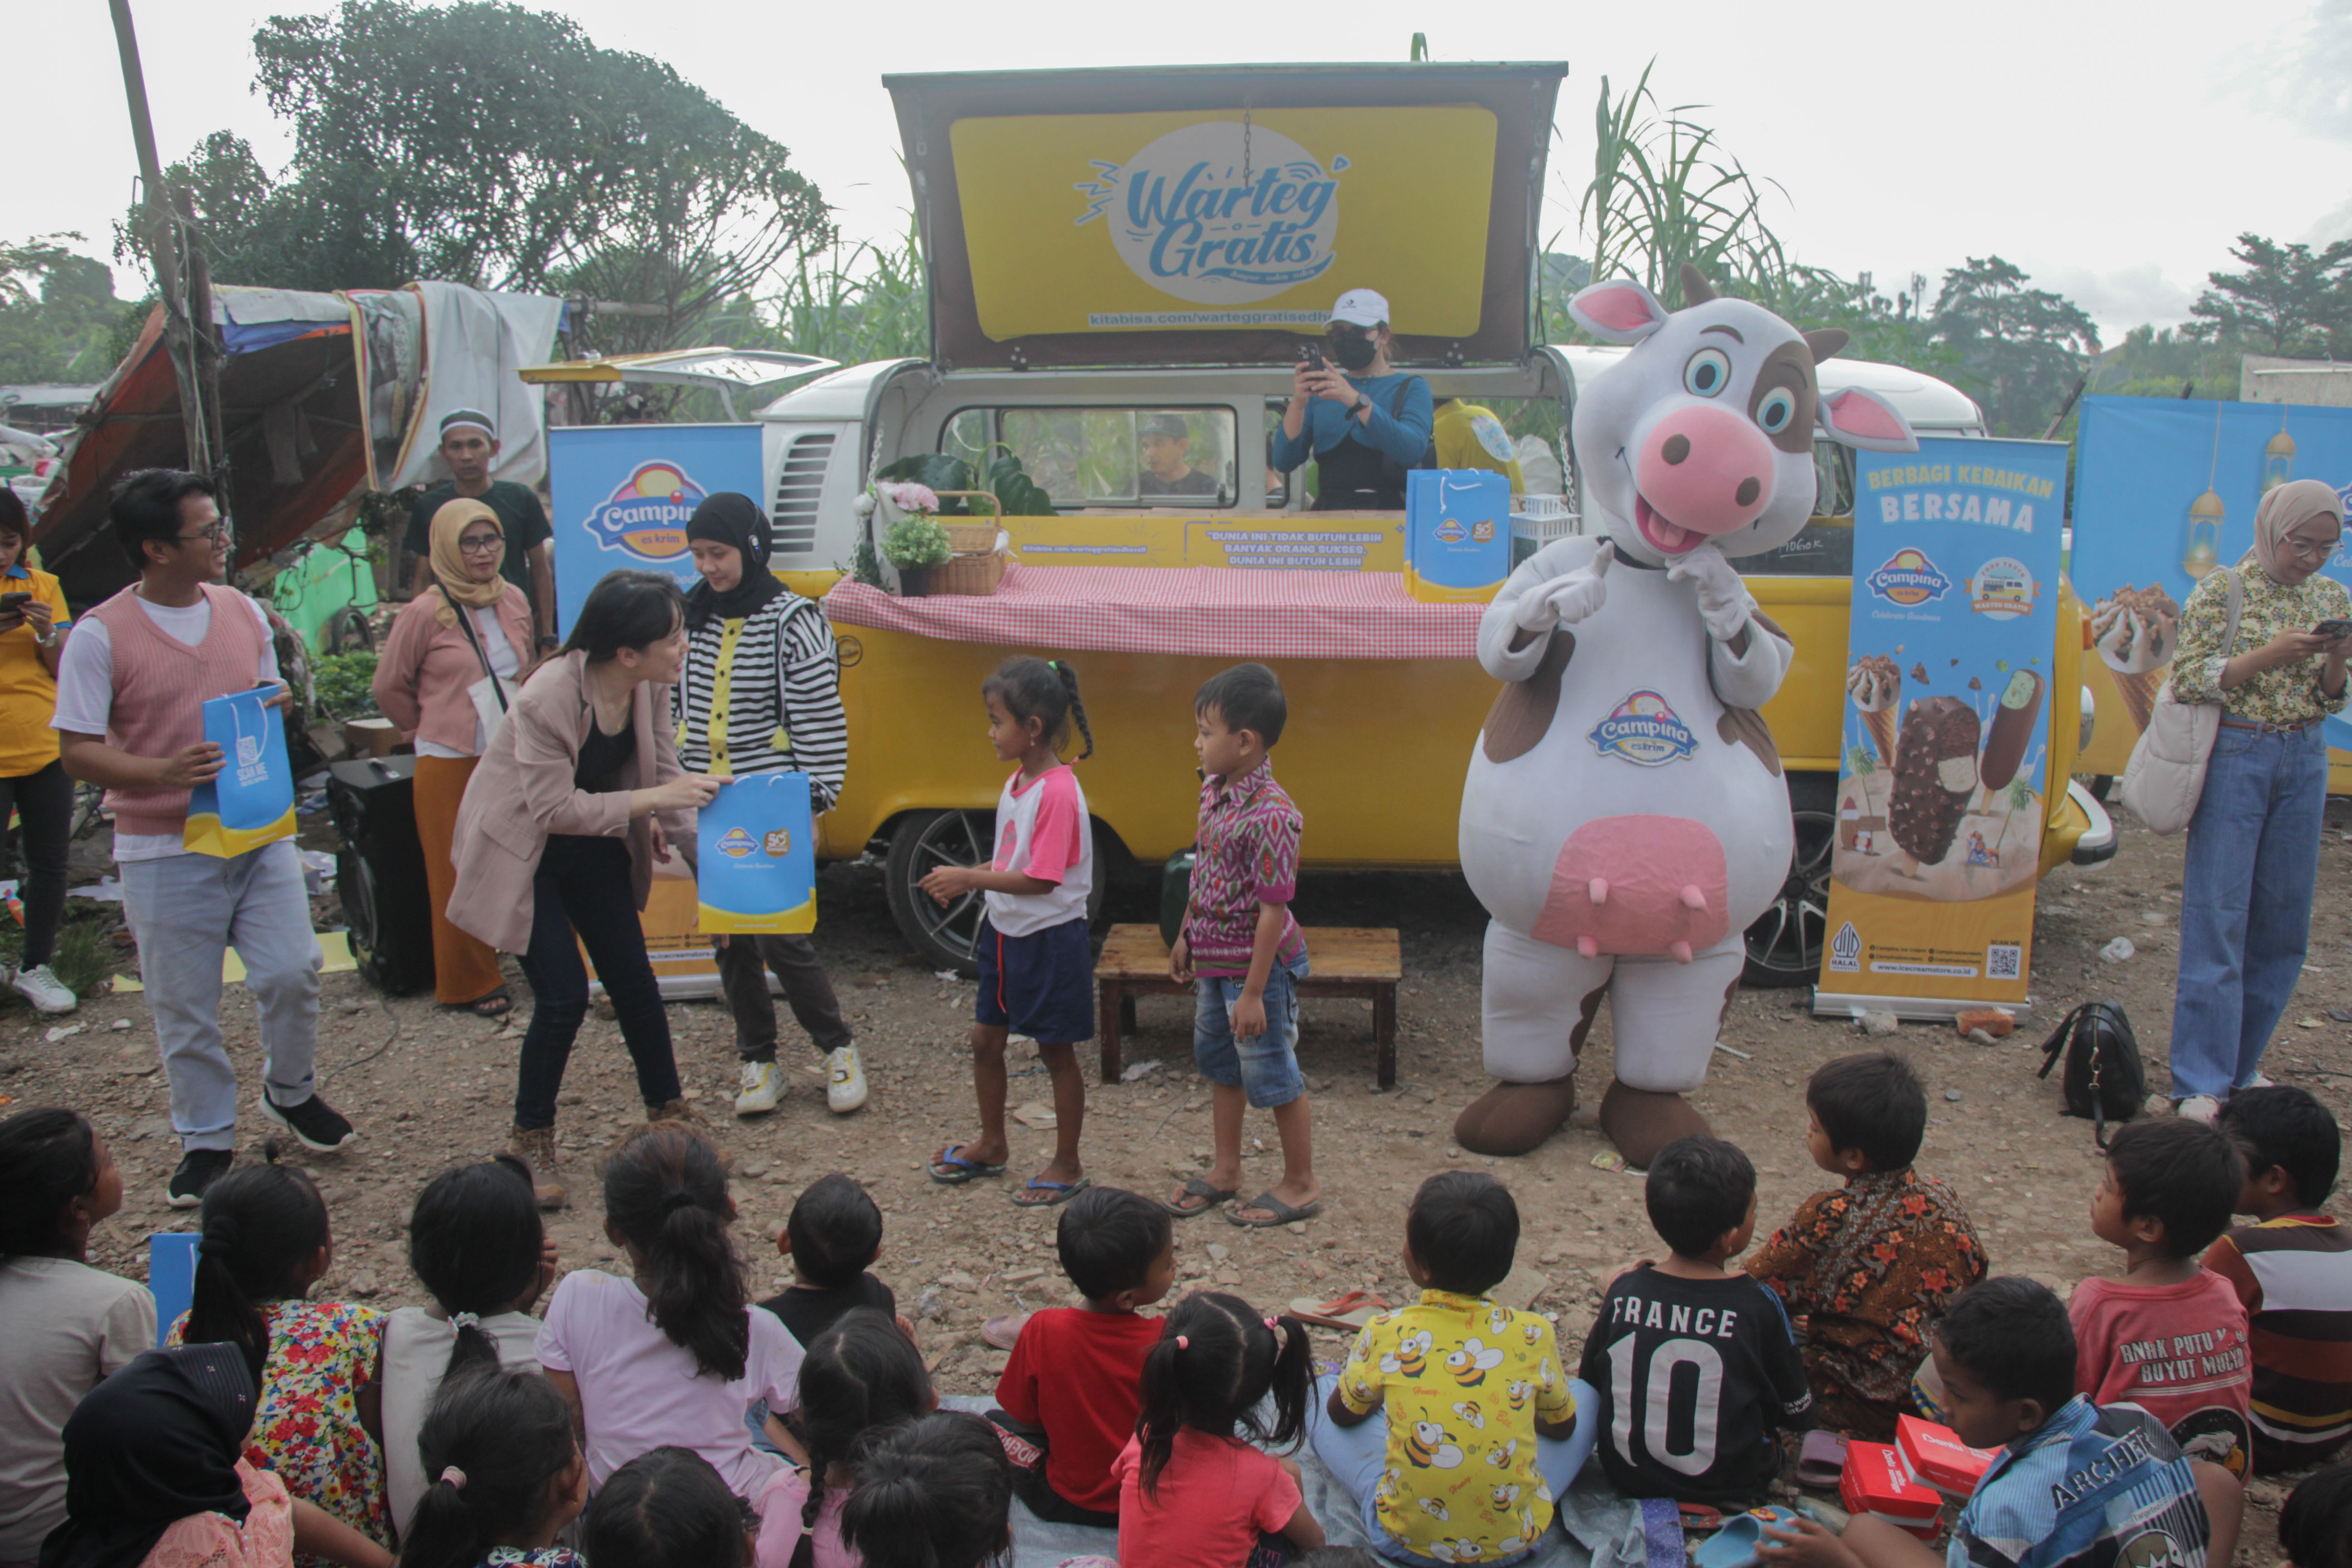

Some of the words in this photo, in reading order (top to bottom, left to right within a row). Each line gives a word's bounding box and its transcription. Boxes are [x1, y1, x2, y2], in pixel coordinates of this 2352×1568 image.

[1127, 161, 1337, 229] Warteg
[1149, 218, 1318, 277] Gratis
[1090, 311, 1333, 326] kitabisa.com/warteggratisedh
[1868, 465, 1950, 490] BERBAGI
[1958, 465, 2054, 499] KEBAIKAN
[1880, 493, 2034, 533] BERSAMA
[655, 534, 680, 543] krim
[1251, 532, 1268, 541] INI
[1271, 532, 1305, 542] TIDAK
[1307, 533, 1347, 542] BUTUH
[1348, 533, 1382, 542] LEBIH
[1225, 545, 1272, 554] BANYAK
[1275, 545, 1315, 554] ORANG
[1229, 556, 1265, 566] DUNIA
[1269, 557, 1284, 566] INI
[1287, 557, 1326, 566] BUTUH
[1328, 558, 1362, 567] LEBIH
[1981, 563, 1999, 576] FOOD
[2004, 562, 2025, 578] TRUCK
[1876, 573, 1942, 588] Campina
[1601, 721, 1688, 743] Campina
[1642, 743, 1664, 751] krim
[1877, 965, 1971, 975] www.icecreamstore.co.id
[1612, 1296, 1737, 1338] FRANCE
[2173, 1331, 2214, 1357] PUTU
[2141, 1359, 2196, 1383] BUYUT
[1607, 1332, 1723, 1476] 10
[2052, 1426, 2156, 1511] ARCHER
